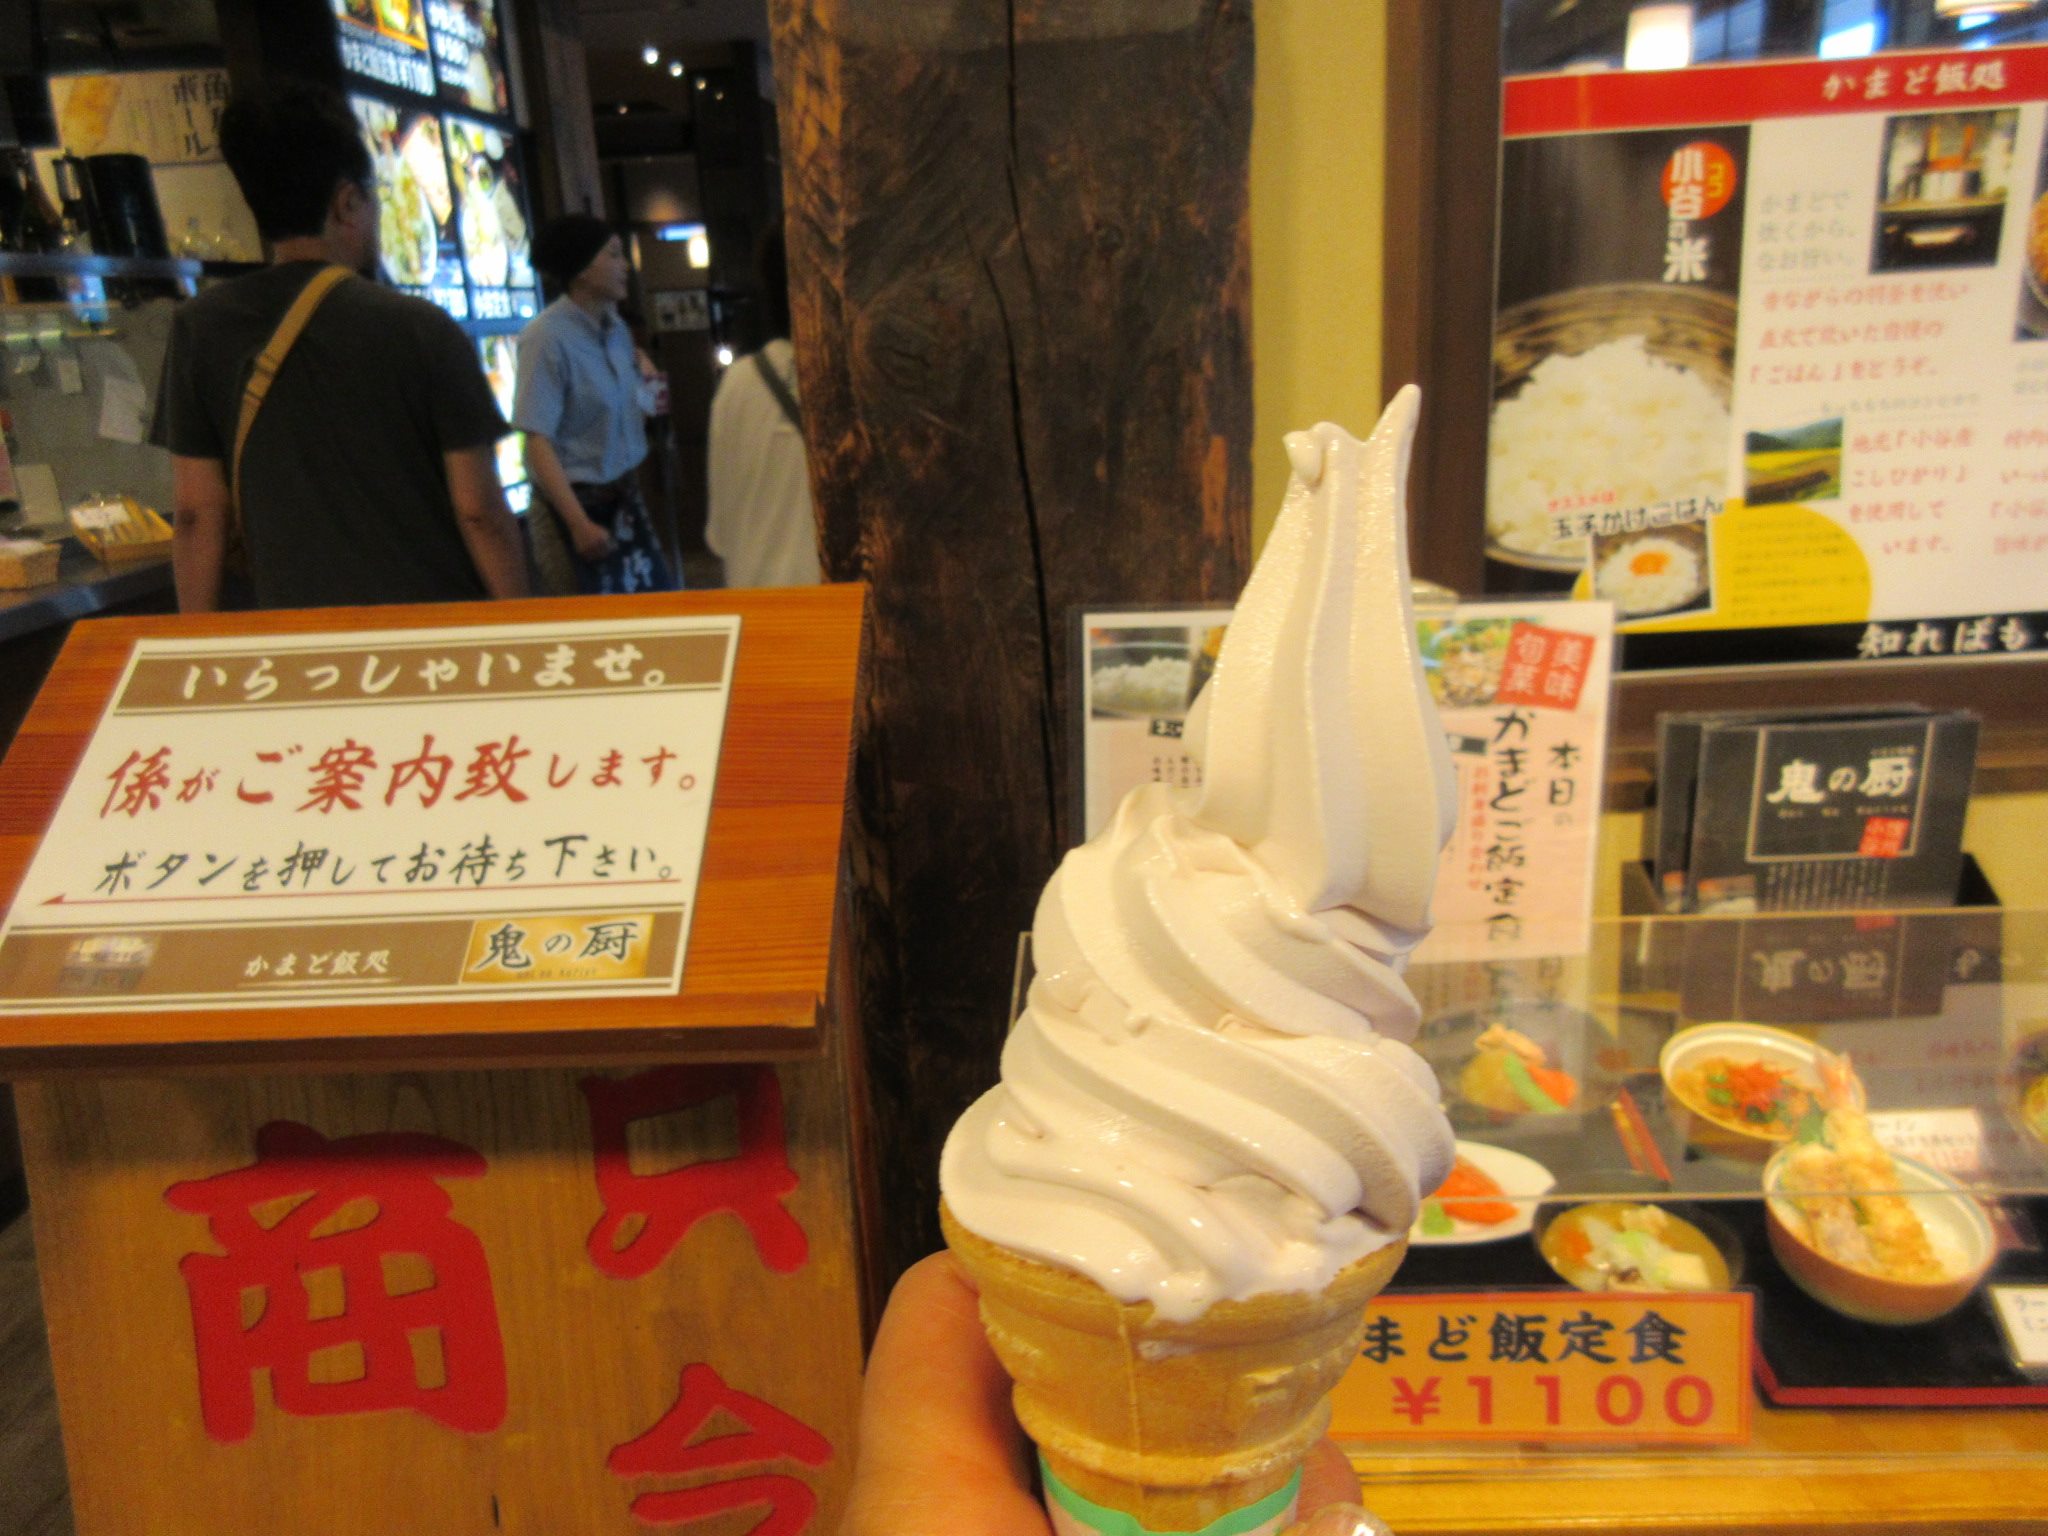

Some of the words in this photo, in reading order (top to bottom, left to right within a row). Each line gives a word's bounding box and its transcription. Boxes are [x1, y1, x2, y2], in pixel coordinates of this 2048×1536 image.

[1822, 58, 2007, 100] かまど飯処
[1857, 616, 2048, 660] 知ればも
[182, 642, 668, 700] いらっしゃいませ。
[98, 734, 698, 819] 係がご案内致します。
[1766, 755, 1915, 804] 鬼の厨
[93, 834, 675, 895] ボタンを押してお待ち下さい。
[244, 949, 390, 977] かまど飯処
[475, 921, 639, 971] 鬼の厨
[163, 1120, 508, 1444] 商
[1390, 1374, 1715, 1427] ¥1100
